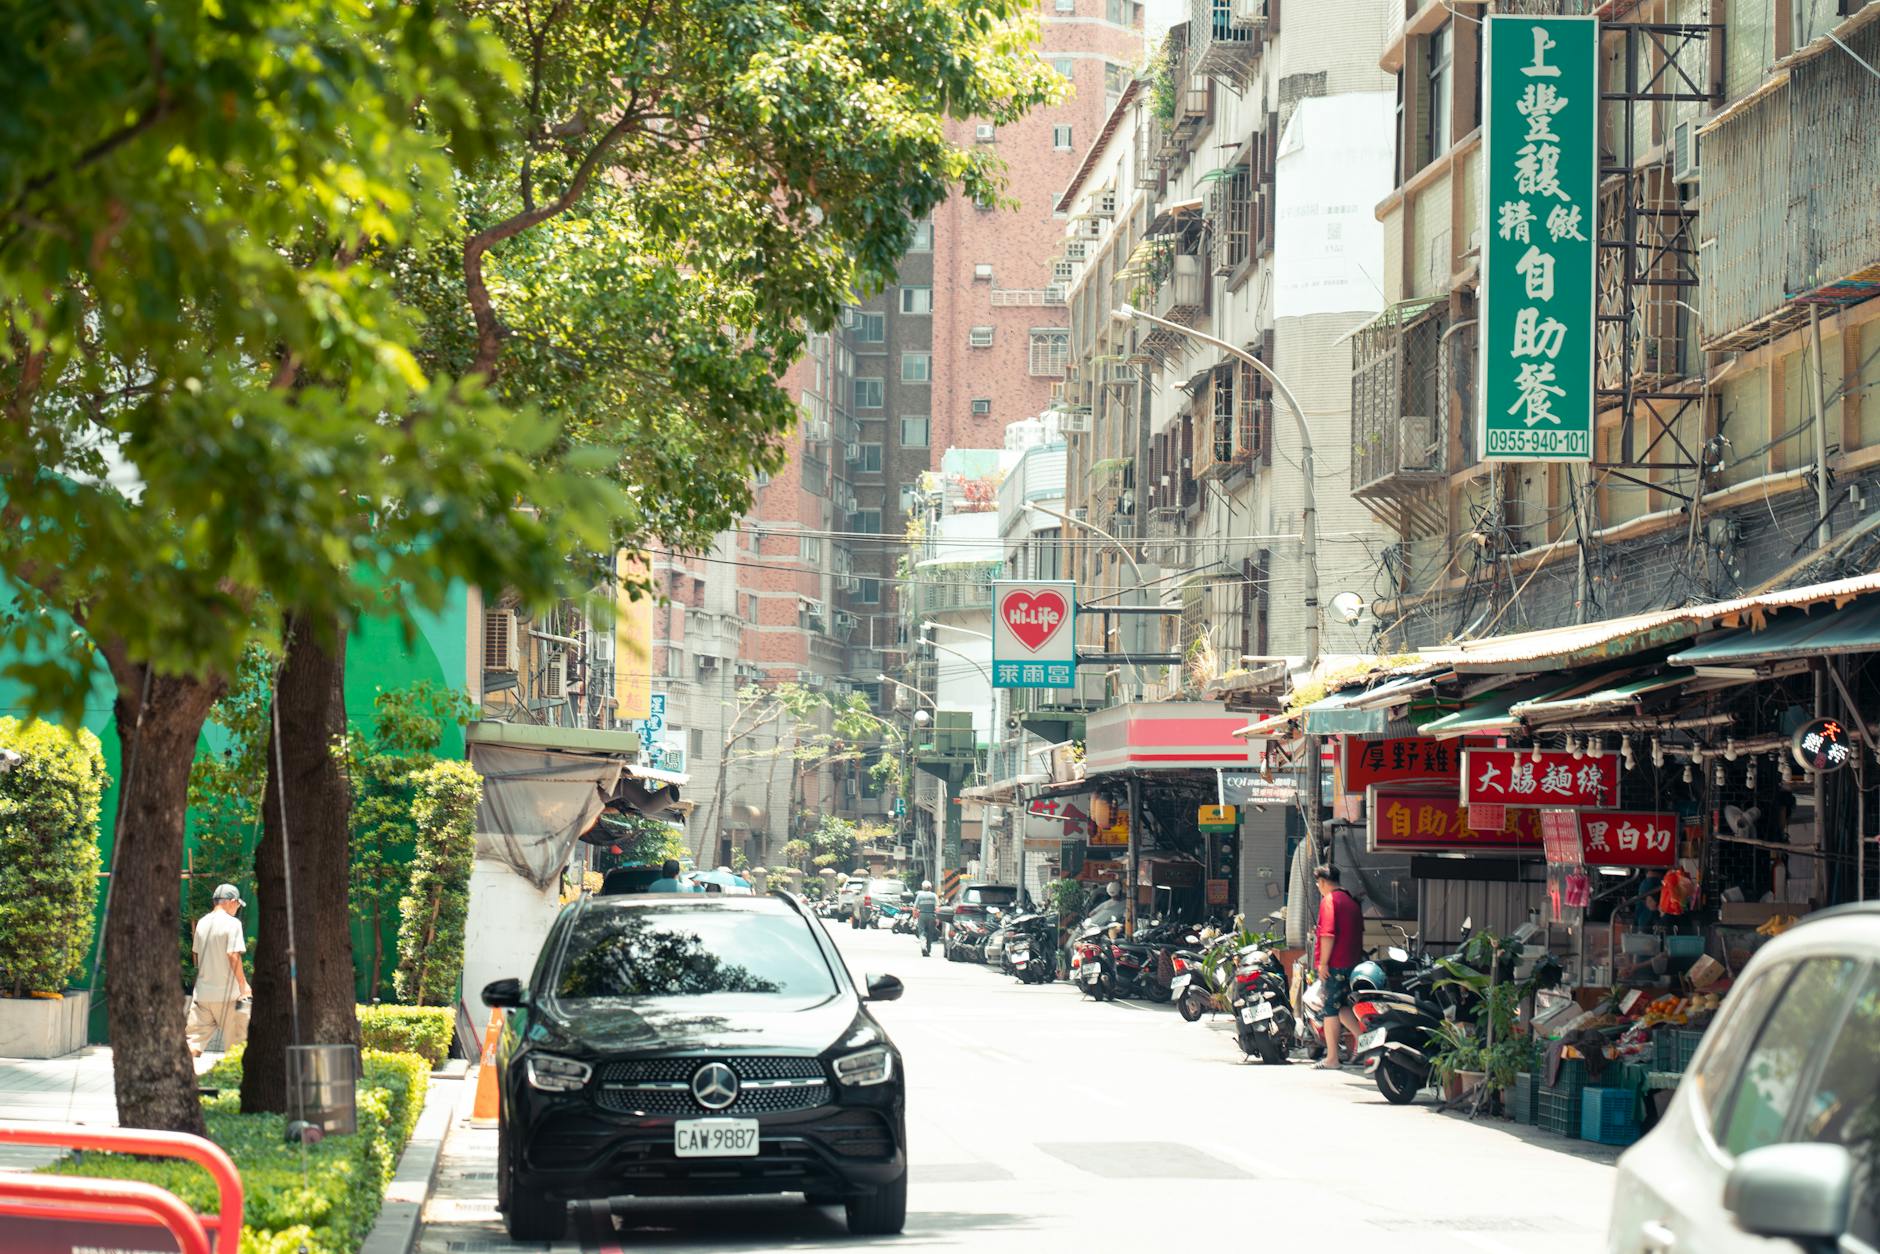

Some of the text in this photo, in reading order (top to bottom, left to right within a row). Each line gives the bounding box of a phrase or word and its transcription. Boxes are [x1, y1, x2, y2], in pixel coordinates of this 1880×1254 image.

[1490, 430, 1586, 451] 0955-940-101
[1009, 603, 1060, 633] Hi-Life
[998, 664, 1070, 684] 萊爾富
[1585, 820, 1672, 853] 黑白切
